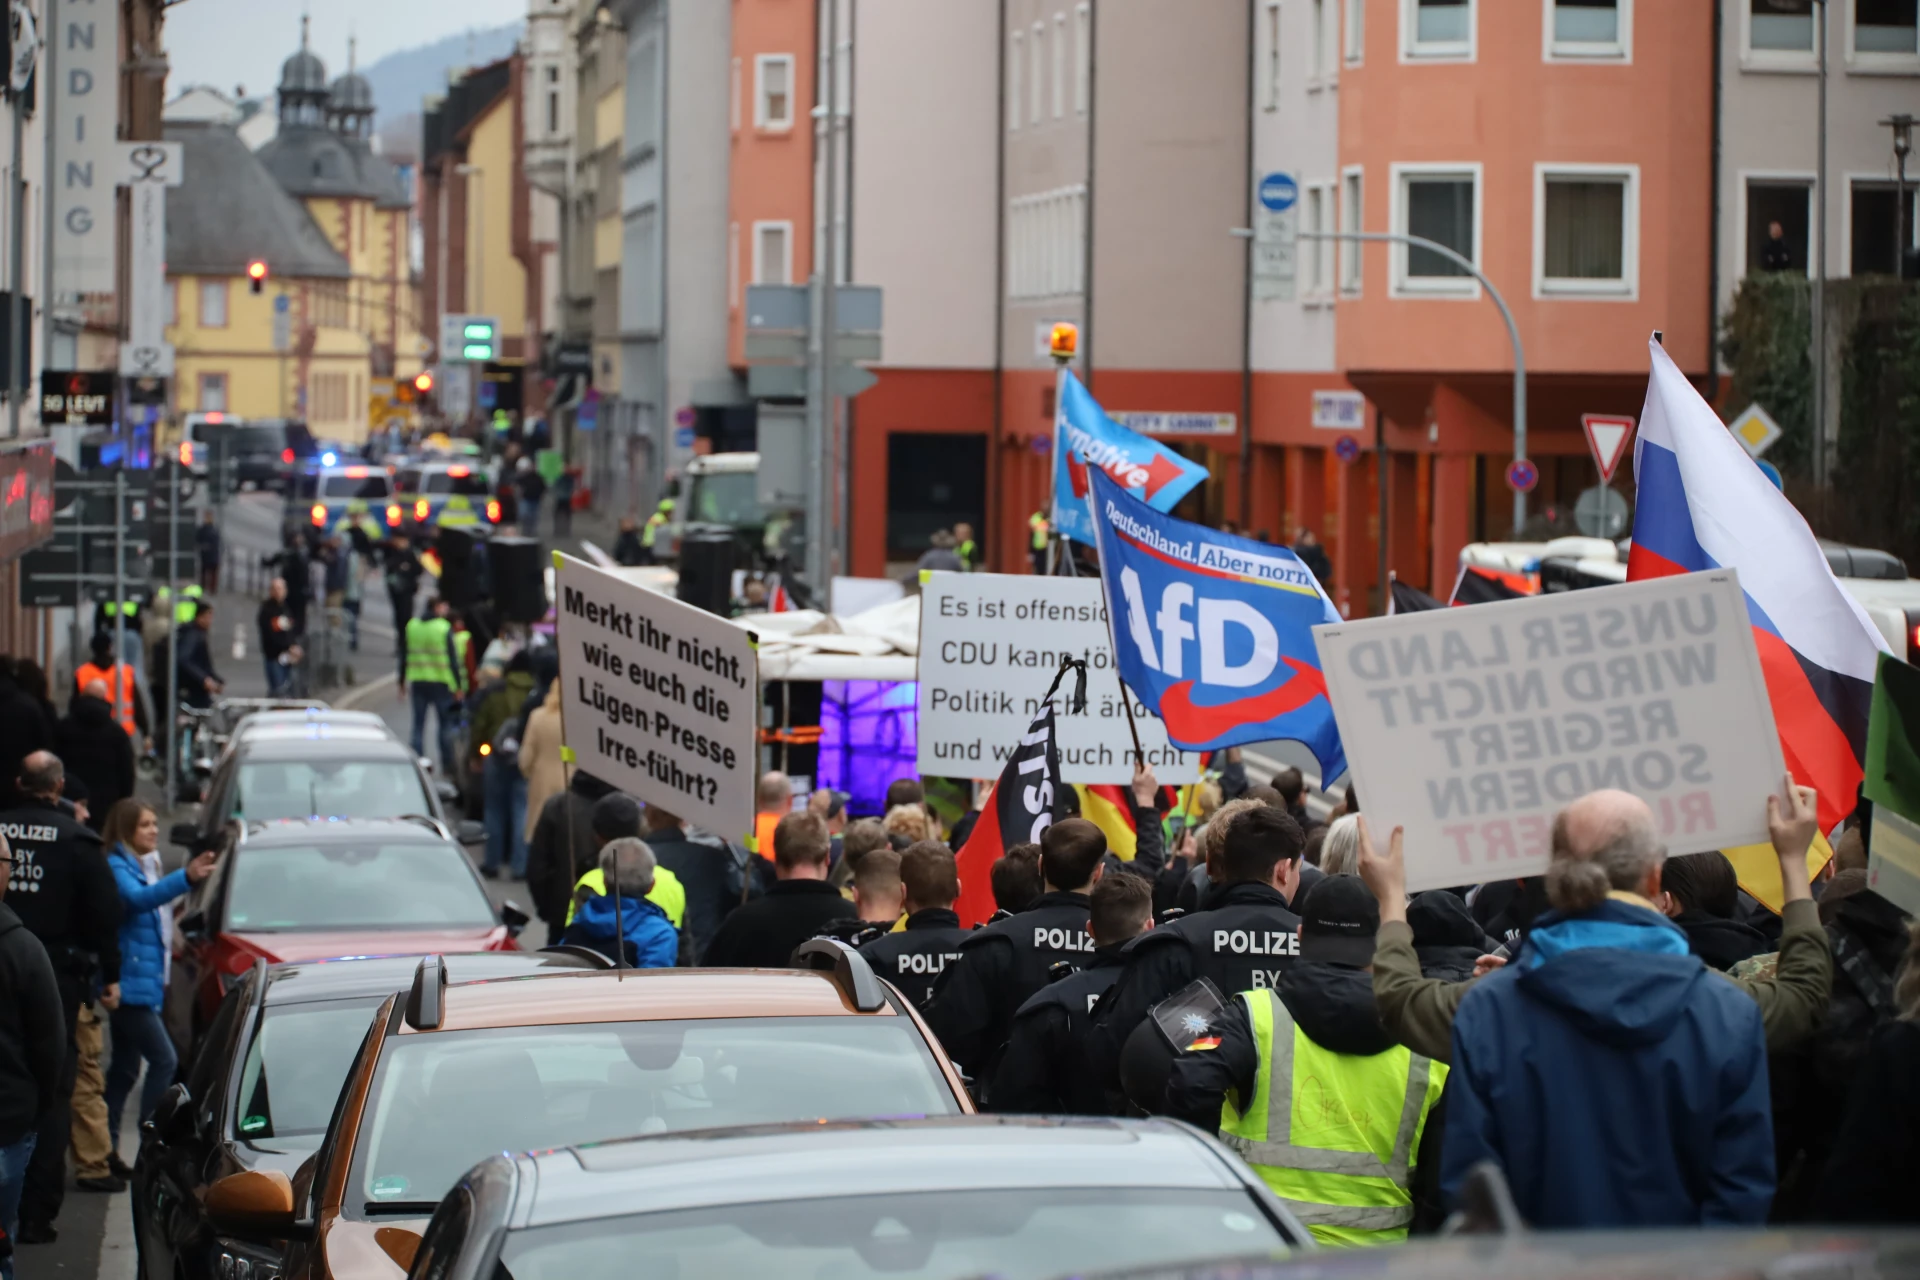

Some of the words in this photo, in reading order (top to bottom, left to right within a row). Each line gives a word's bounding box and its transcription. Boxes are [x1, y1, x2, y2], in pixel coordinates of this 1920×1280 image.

[65, 0, 96, 236] NDING
[1106, 499, 1198, 564] Deutschland.
[1201, 549, 1253, 574] Aber
[940, 596, 969, 617] Es
[977, 597, 1006, 619] ist
[564, 586, 633, 639] Merkt
[639, 616, 671, 654] ihr
[678, 637, 746, 689] nicht,
[941, 641, 997, 666] CDU
[582, 641, 623, 677] wie
[629, 663, 686, 705] euch
[692, 684, 730, 722] die
[931, 688, 1014, 714] Politik
[1024, 692, 1089, 717] ncht
[934, 738, 982, 762] und
[597, 728, 719, 806] Irre-führt?
[0, 823, 58, 842] POLIZEI
[15, 848, 36, 864] BY
[1213, 929, 1301, 956] POLIZE
[1251, 969, 1281, 991] BY
